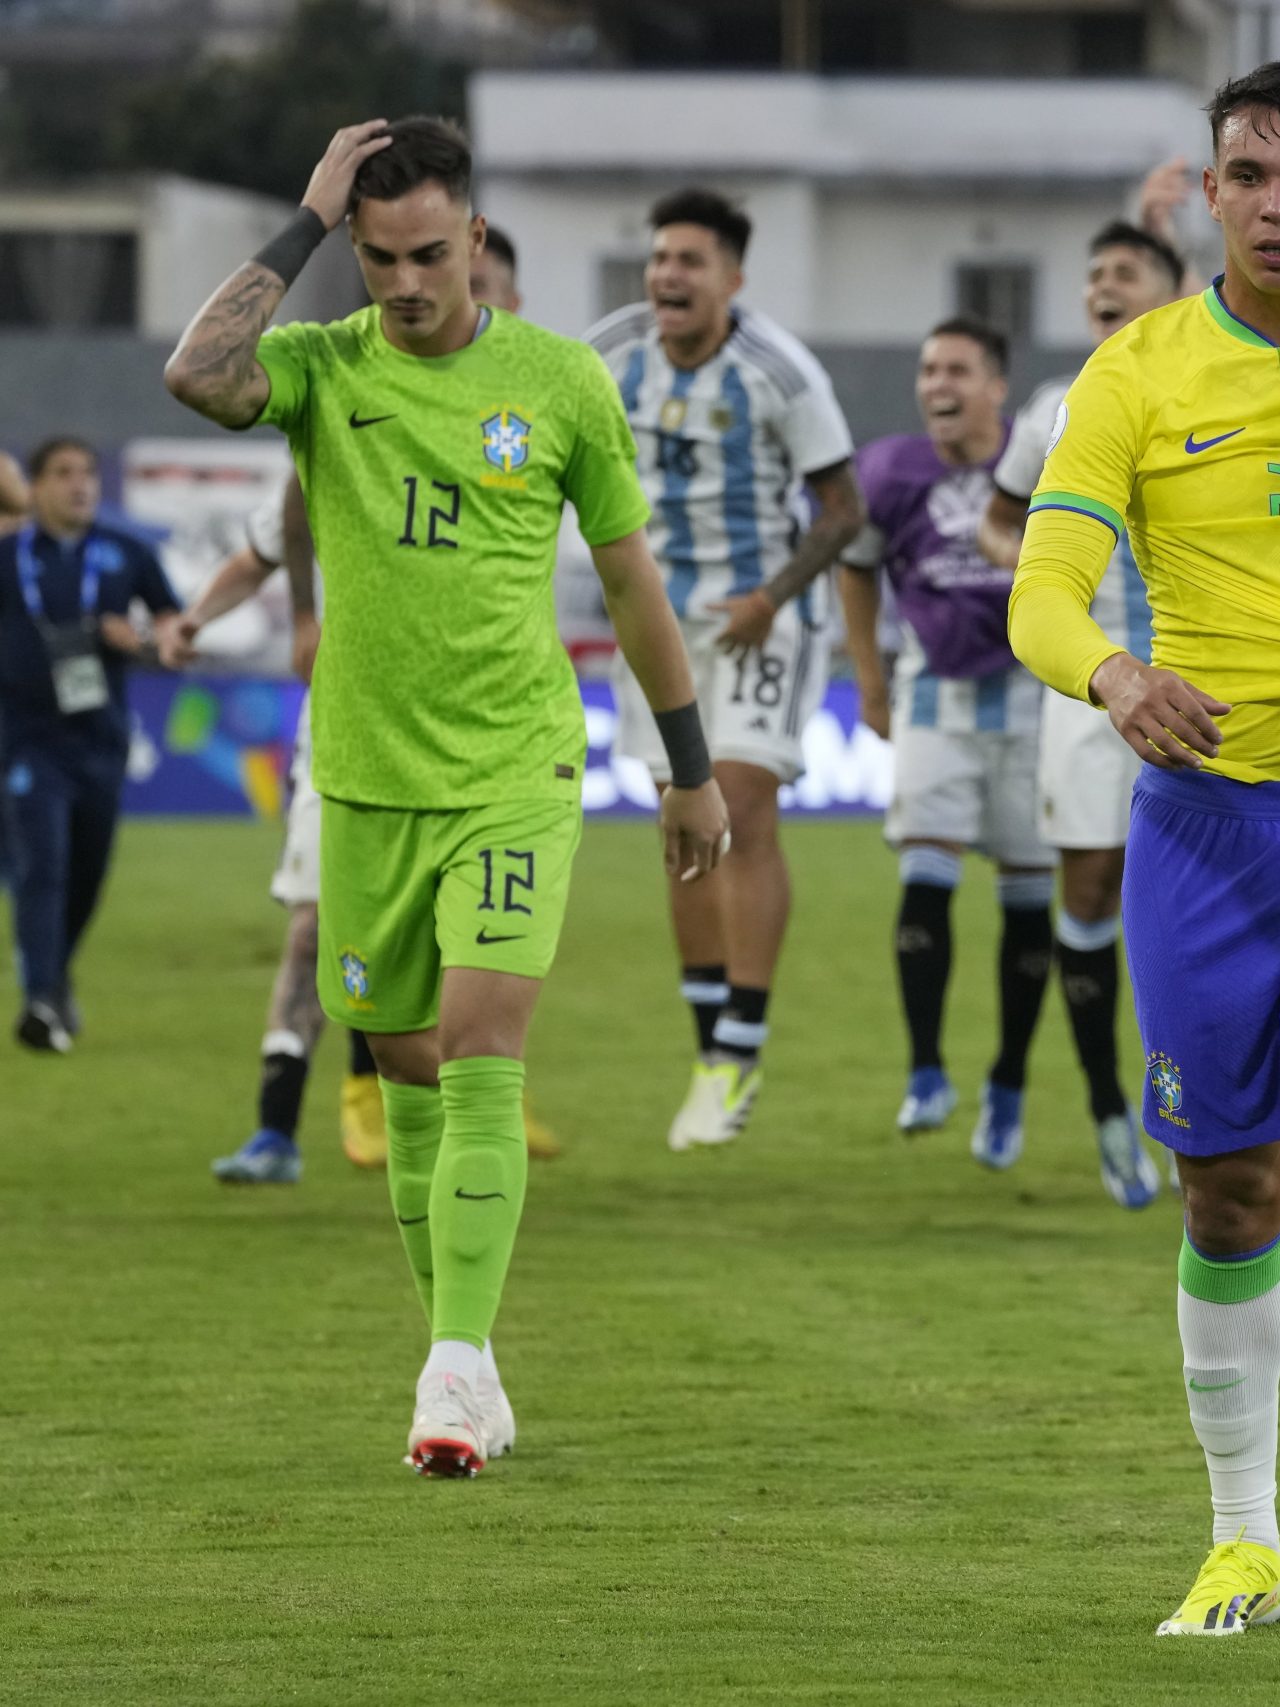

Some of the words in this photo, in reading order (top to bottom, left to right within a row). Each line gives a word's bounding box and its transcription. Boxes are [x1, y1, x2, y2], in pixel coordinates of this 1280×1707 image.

[398, 476, 460, 549] 12
[729, 655, 785, 708] 18
[478, 848, 534, 916] 12
[1158, 1107, 1191, 1128] BRASIL
